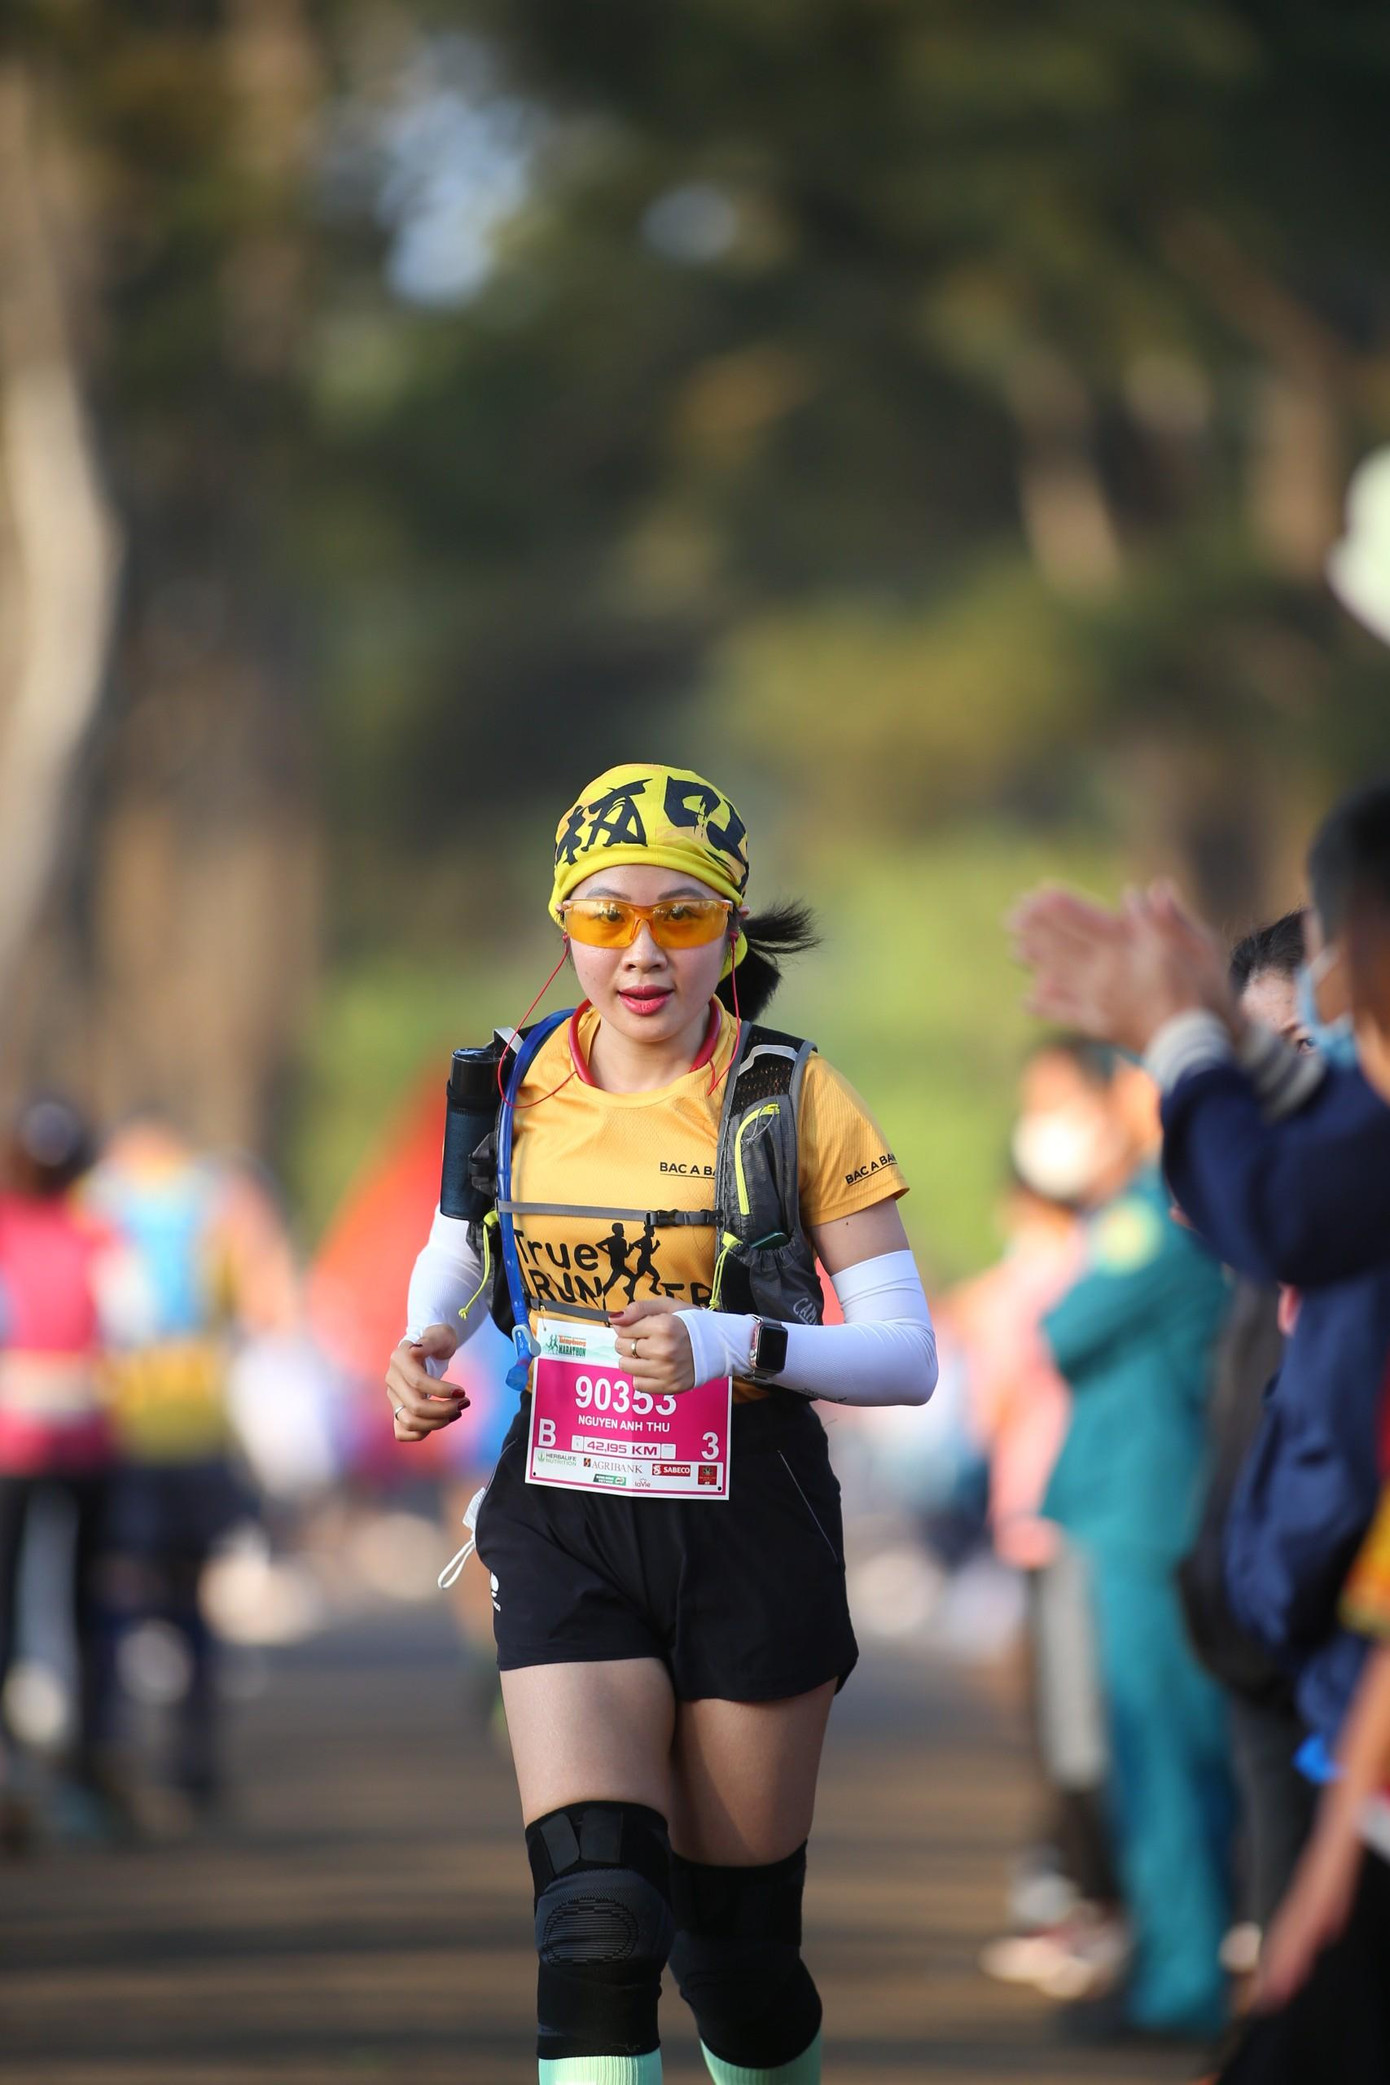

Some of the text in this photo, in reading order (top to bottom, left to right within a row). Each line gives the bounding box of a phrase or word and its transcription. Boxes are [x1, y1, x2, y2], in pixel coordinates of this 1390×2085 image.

[660, 1162, 687, 1173] BAC
[690, 1165, 700, 1174] A
[845, 1166, 869, 1184] BAC
[871, 1161, 879, 1171] A
[514, 1229, 599, 1271] True
[578, 1414, 670, 1433] NGUYEN ANH THU
[538, 1418, 556, 1447] B
[632, 1445, 657, 1455] KM
[701, 1431, 719, 1460] 3
[545, 1453, 577, 1461] HERBALIFE
[592, 1460, 643, 1474] AGRIBANK
[663, 1466, 690, 1474] SABECO
